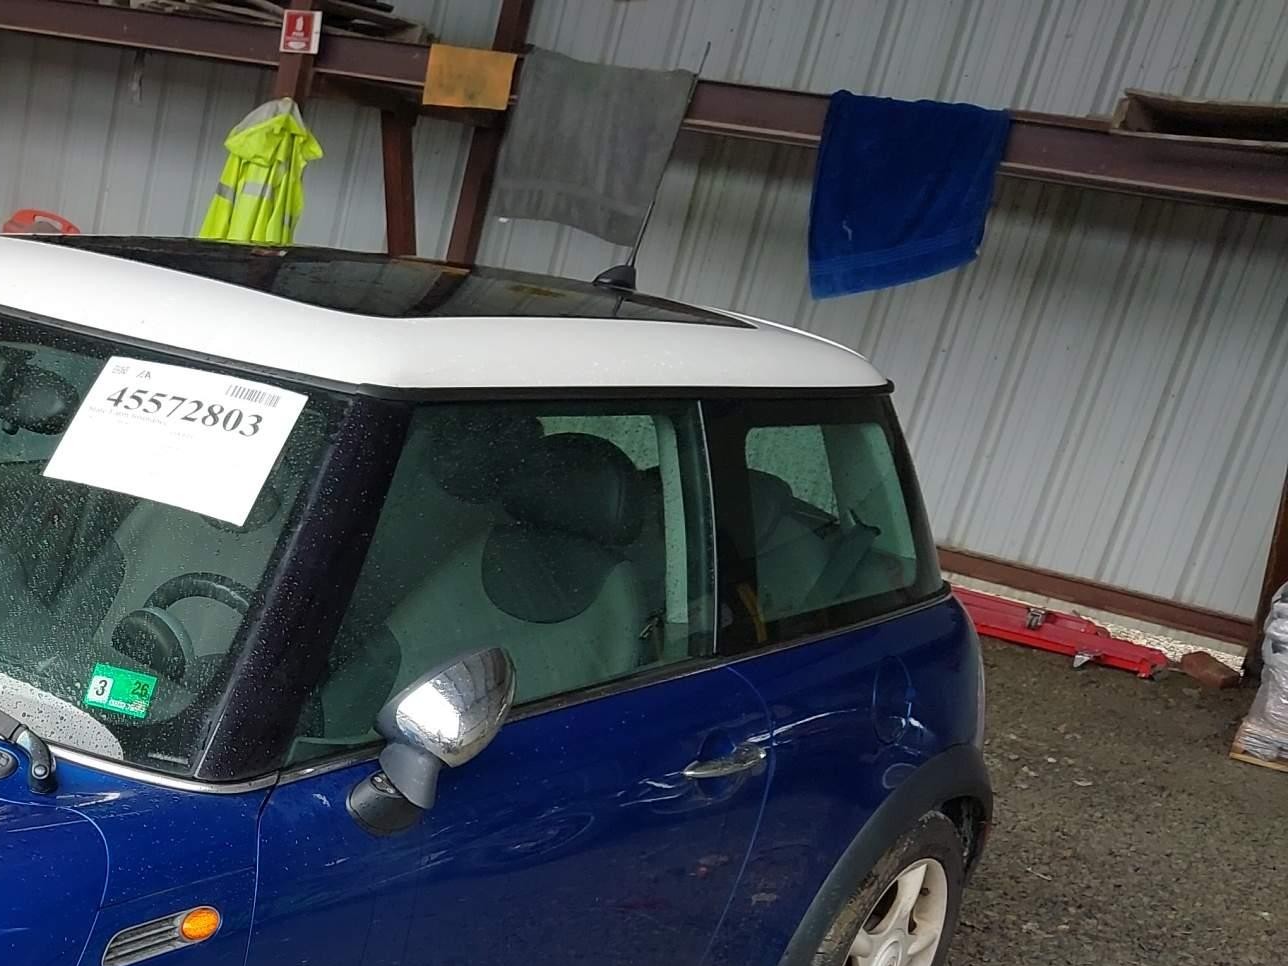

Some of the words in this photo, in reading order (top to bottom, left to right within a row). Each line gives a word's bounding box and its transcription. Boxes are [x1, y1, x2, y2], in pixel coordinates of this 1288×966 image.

[106, 385, 263, 438] 45572803
[95, 679, 108, 697] 3
[131, 681, 150, 697] 26
